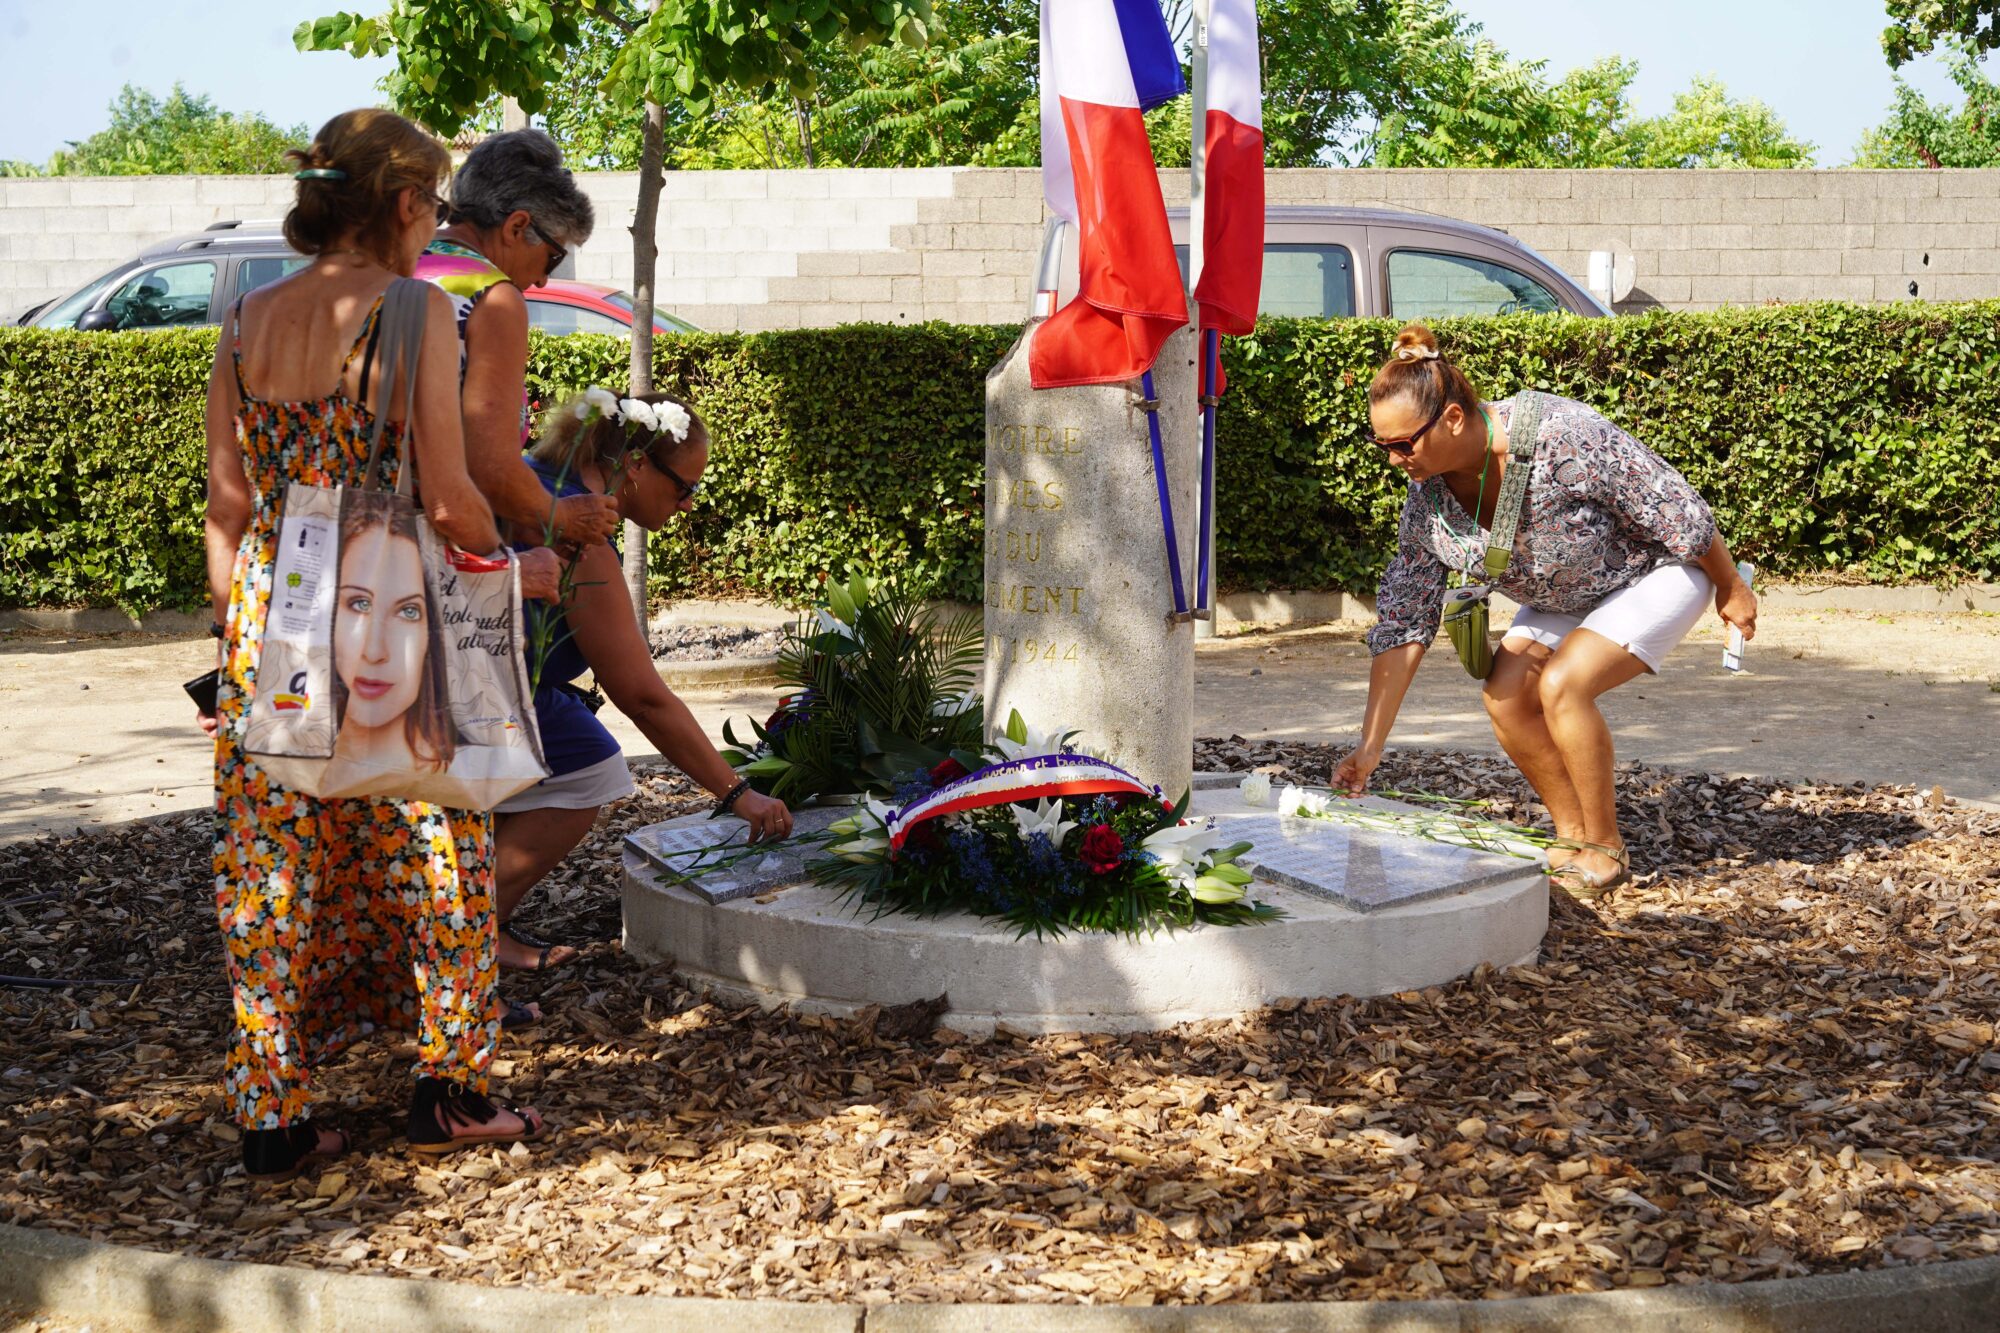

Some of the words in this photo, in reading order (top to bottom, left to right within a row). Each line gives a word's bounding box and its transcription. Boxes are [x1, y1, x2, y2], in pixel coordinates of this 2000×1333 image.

[1005, 531, 1042, 563] DU
[985, 581, 1085, 615] EMENT
[1010, 637, 1080, 666] 1944
[980, 761, 1031, 780] avenir
[1034, 757, 1049, 770] et
[1055, 755, 1112, 770] tradition
